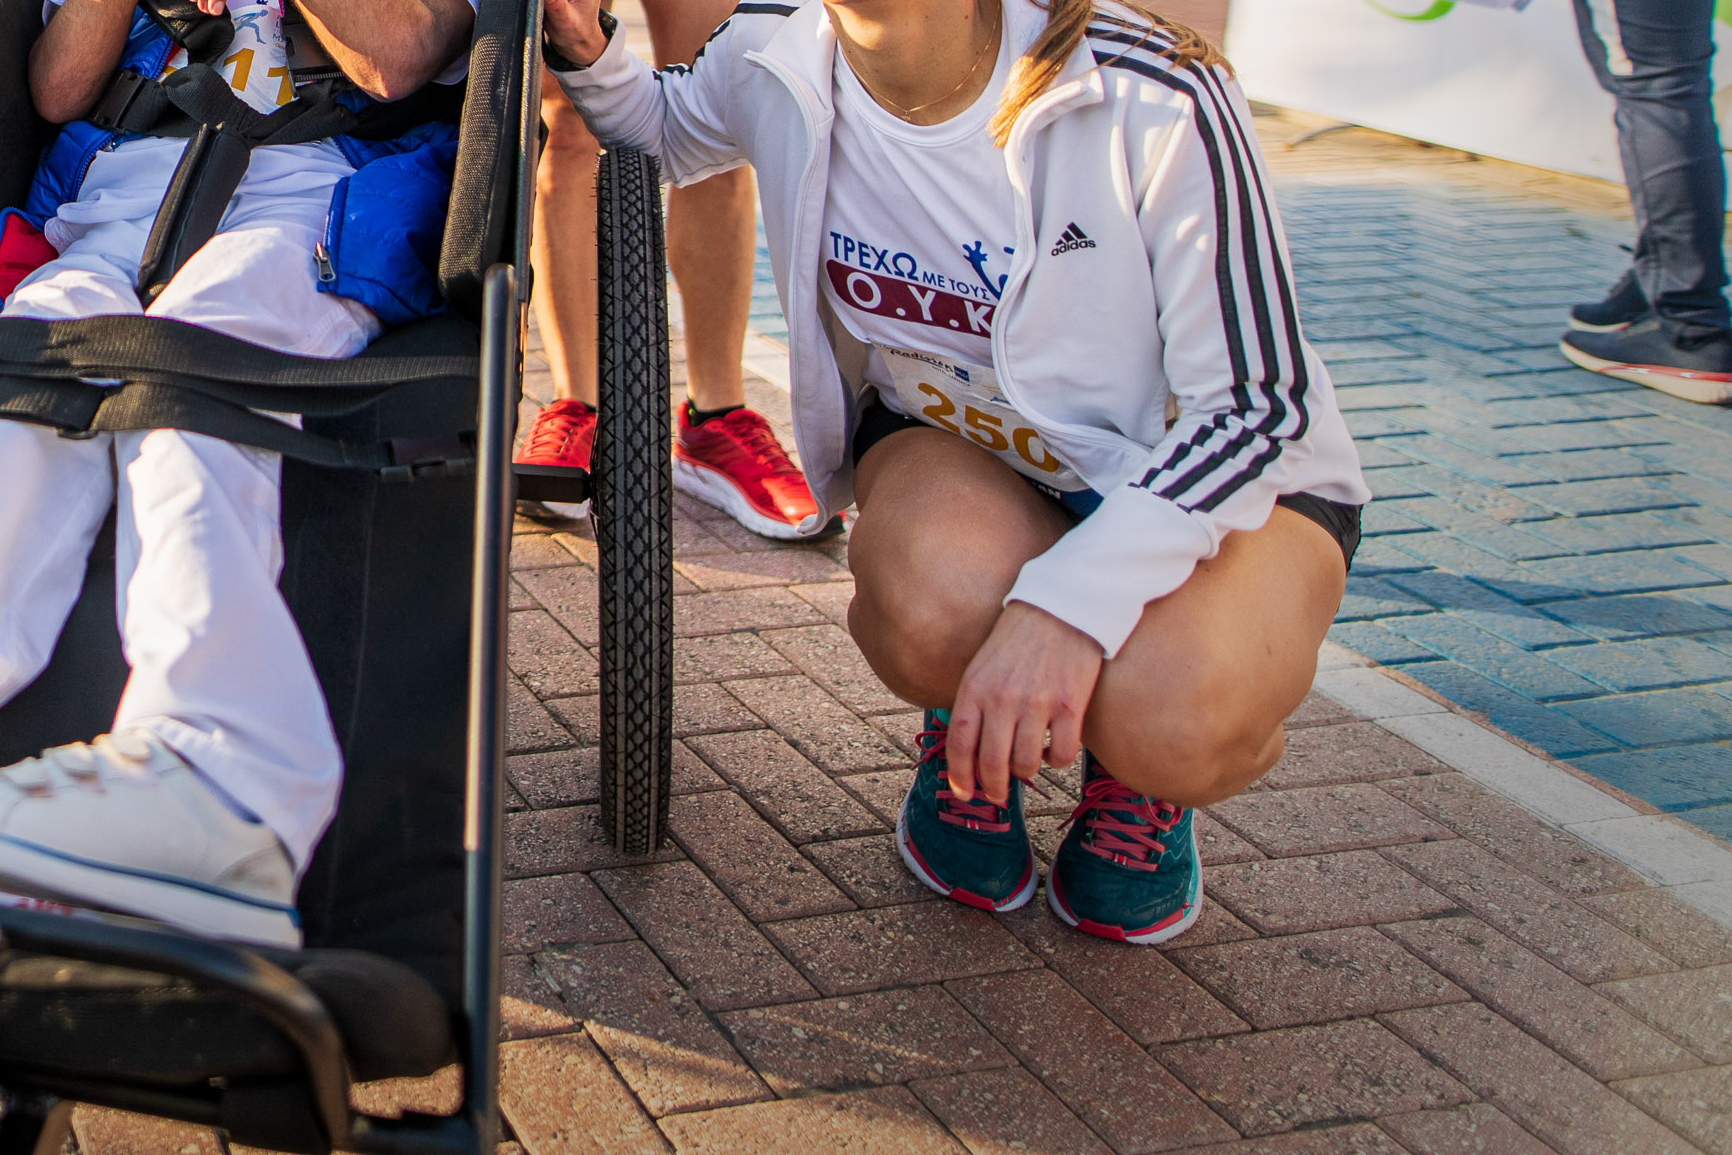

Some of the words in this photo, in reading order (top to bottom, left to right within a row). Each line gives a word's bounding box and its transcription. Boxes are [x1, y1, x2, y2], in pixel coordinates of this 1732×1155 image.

[1051, 239, 1097, 257] adidas
[829, 230, 919, 282] ΤΡΕΧΩ
[923, 270, 946, 288] ΜΕ
[948, 278, 990, 301] ΤΟΥΣ
[890, 348, 954, 373] Radisson
